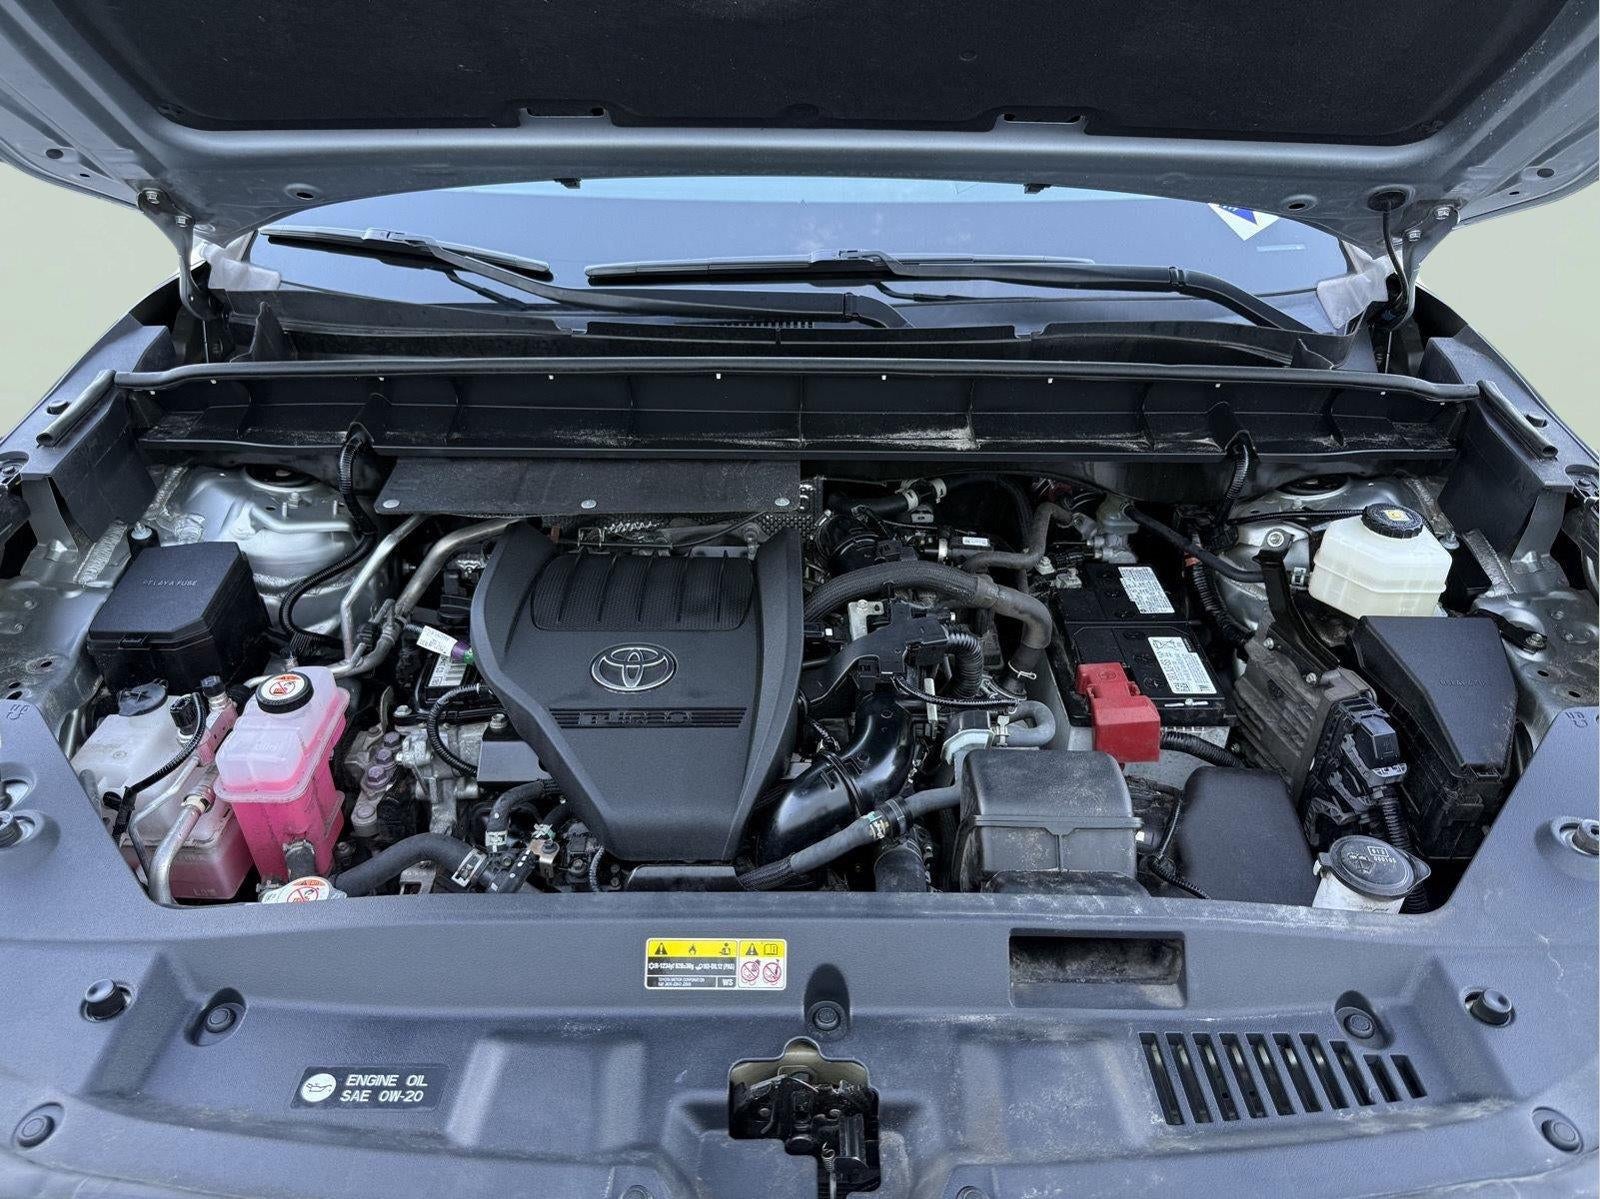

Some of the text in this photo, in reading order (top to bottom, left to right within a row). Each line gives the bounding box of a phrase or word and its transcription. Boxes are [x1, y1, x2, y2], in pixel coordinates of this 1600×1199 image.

[577, 711, 693, 726] TURBO
[722, 978, 734, 986] WS
[345, 1074, 428, 1087] ENGINE OIL
[340, 1090, 424, 1103] SAE 0W-20
